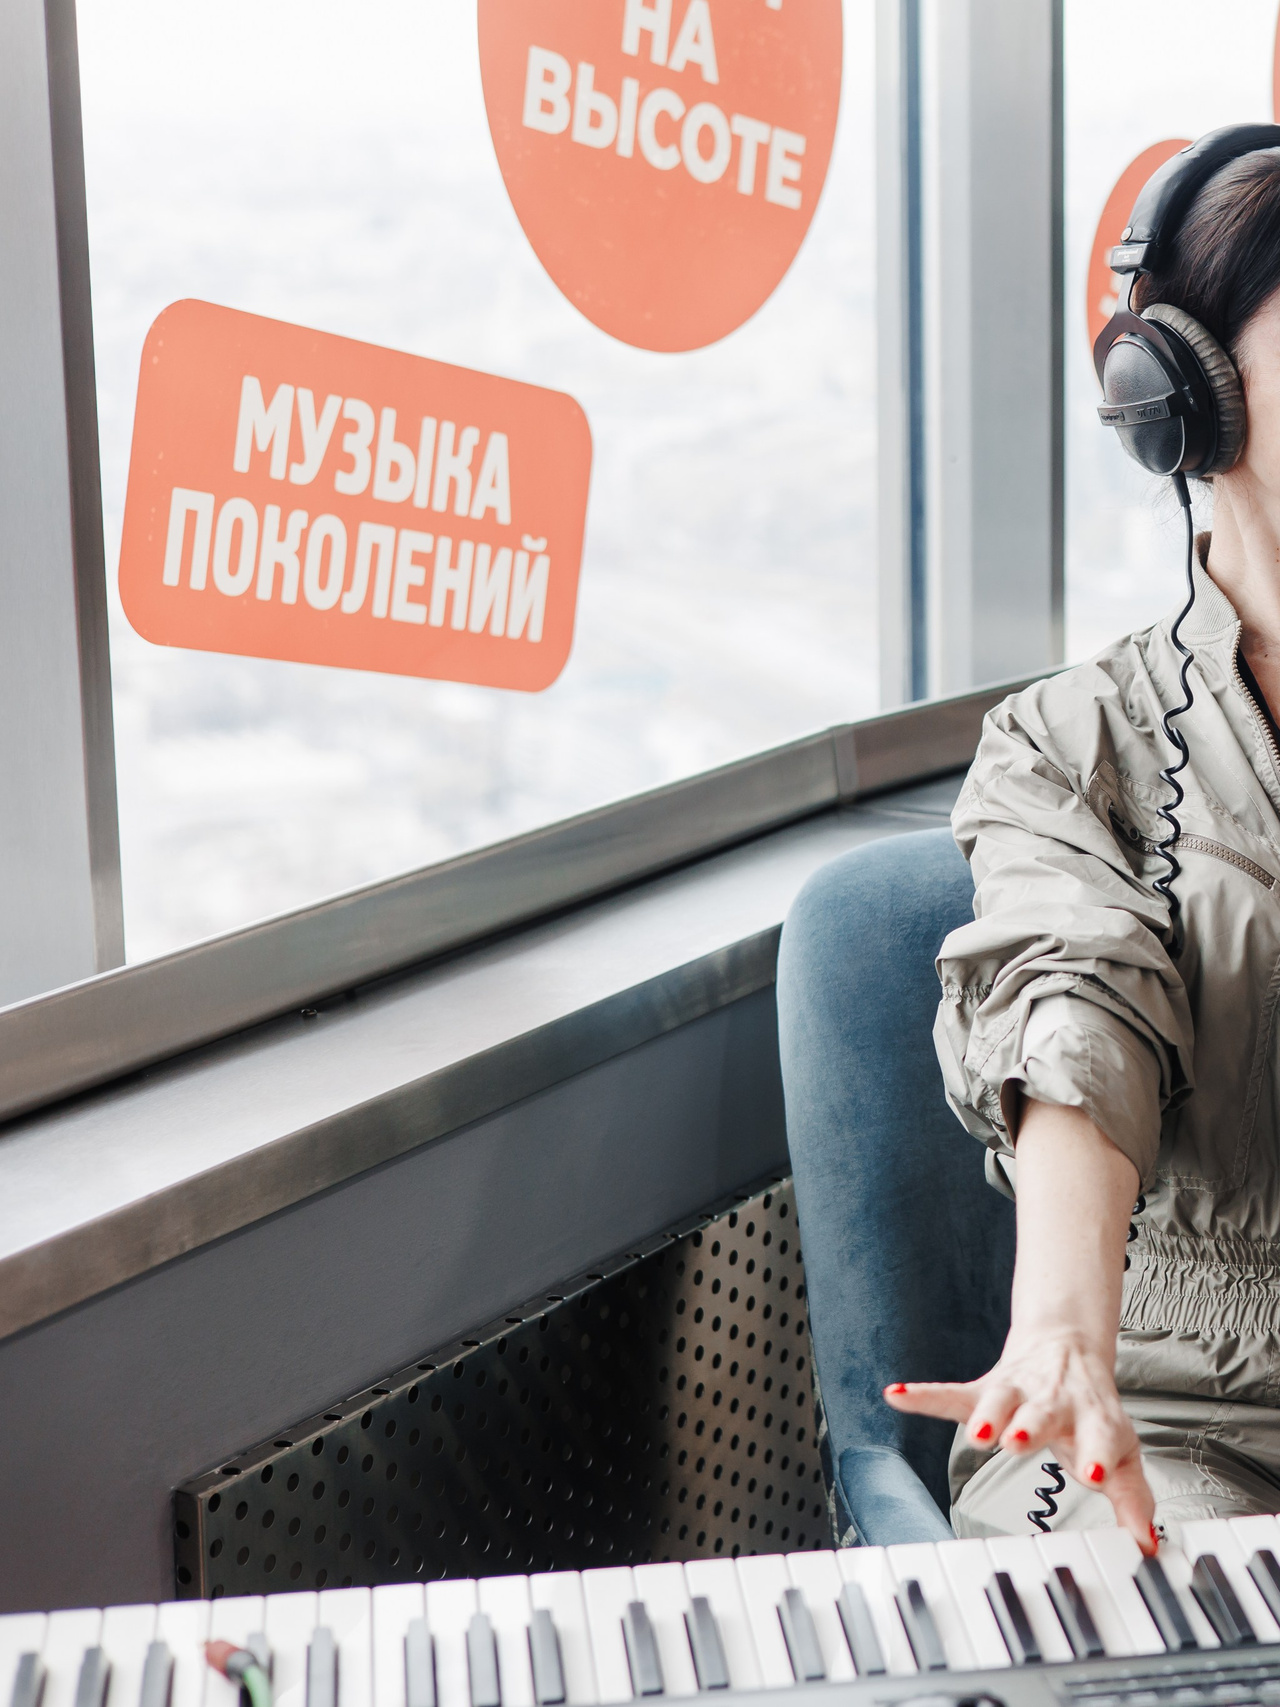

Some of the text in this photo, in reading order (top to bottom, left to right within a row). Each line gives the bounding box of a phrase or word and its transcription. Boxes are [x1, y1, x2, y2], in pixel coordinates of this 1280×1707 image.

[622, 0, 719, 84] НА
[523, 46, 806, 210] ВЫСОТЕ
[233, 375, 511, 525] МУЗЫКА
[163, 487, 550, 643] ПОКОЛЕНИЙ
